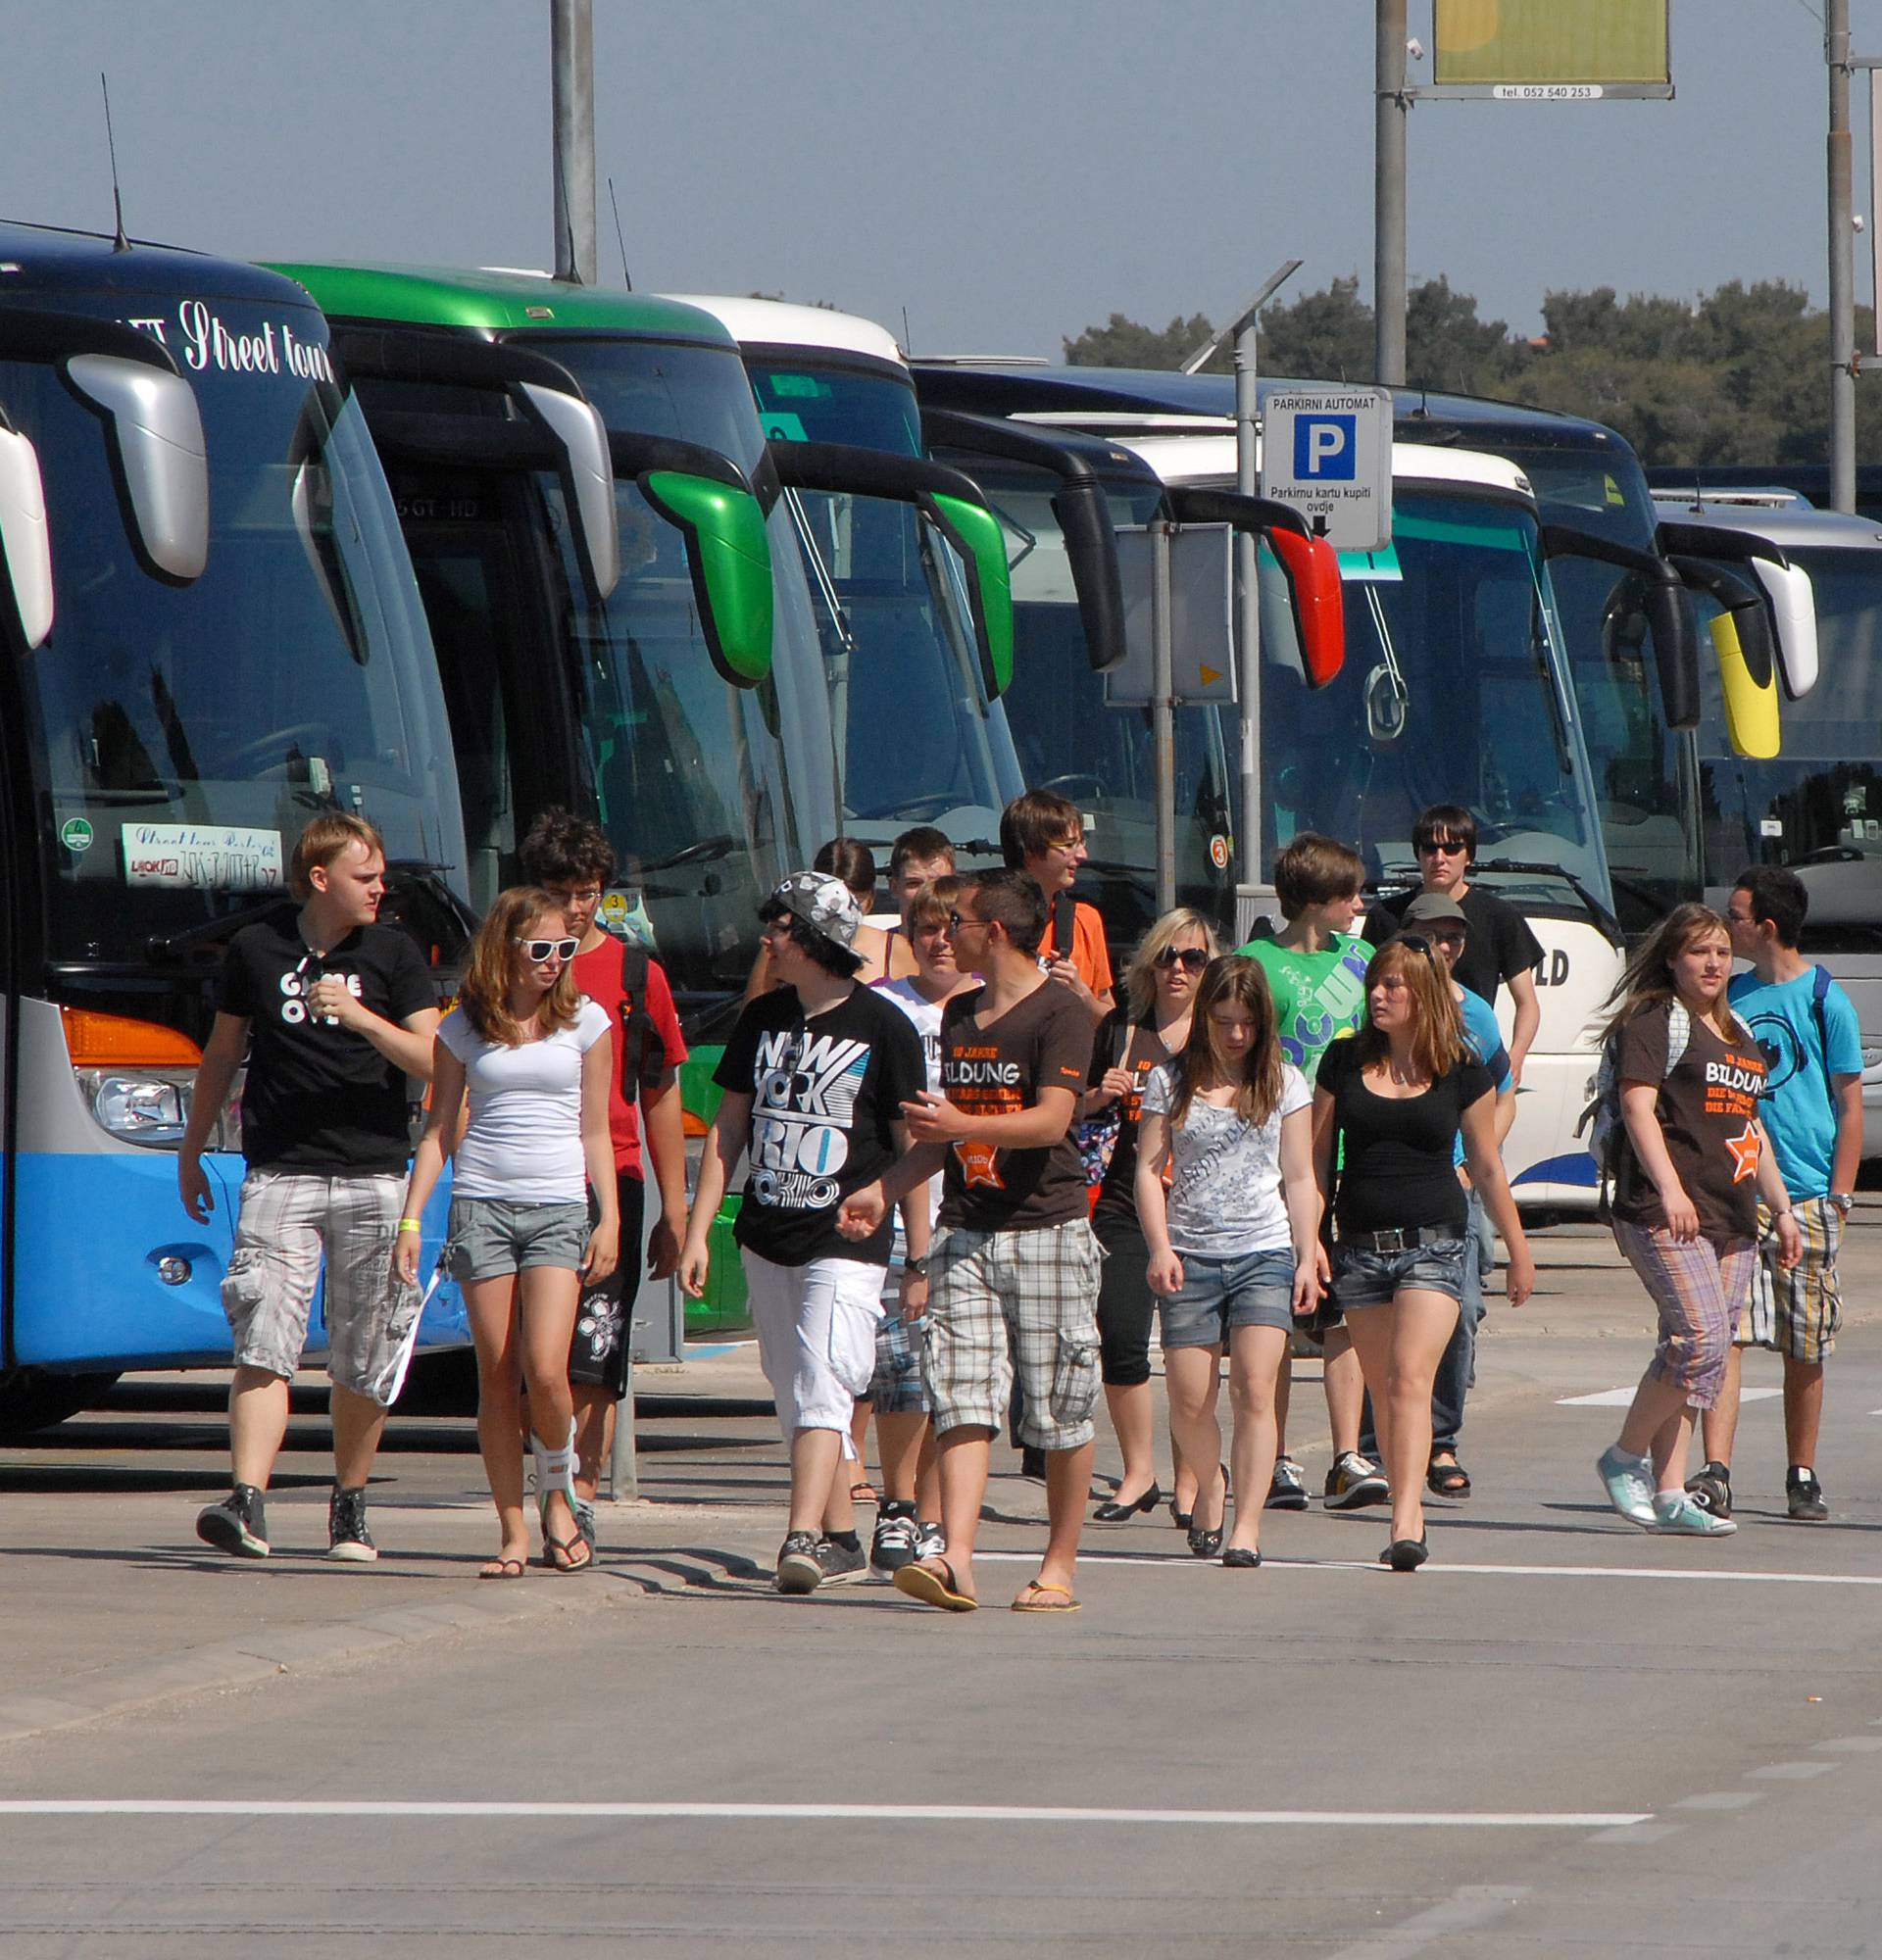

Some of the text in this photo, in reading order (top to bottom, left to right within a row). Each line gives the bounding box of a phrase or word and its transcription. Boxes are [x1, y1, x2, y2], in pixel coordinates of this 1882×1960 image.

[1503, 86, 1591, 97] tel. 052 540 253
[178, 300, 279, 374] Street
[1273, 397, 1375, 410] PARKIRNI AUTOMAT
[1309, 423, 1345, 473] P
[1315, 487, 1341, 499] kartu
[1344, 487, 1371, 501] kupiti
[1307, 502, 1334, 514] ovdje
[1215, 844, 1225, 863] 3
[612, 894, 619, 907] 3
[749, 1115, 849, 1176] RIO
